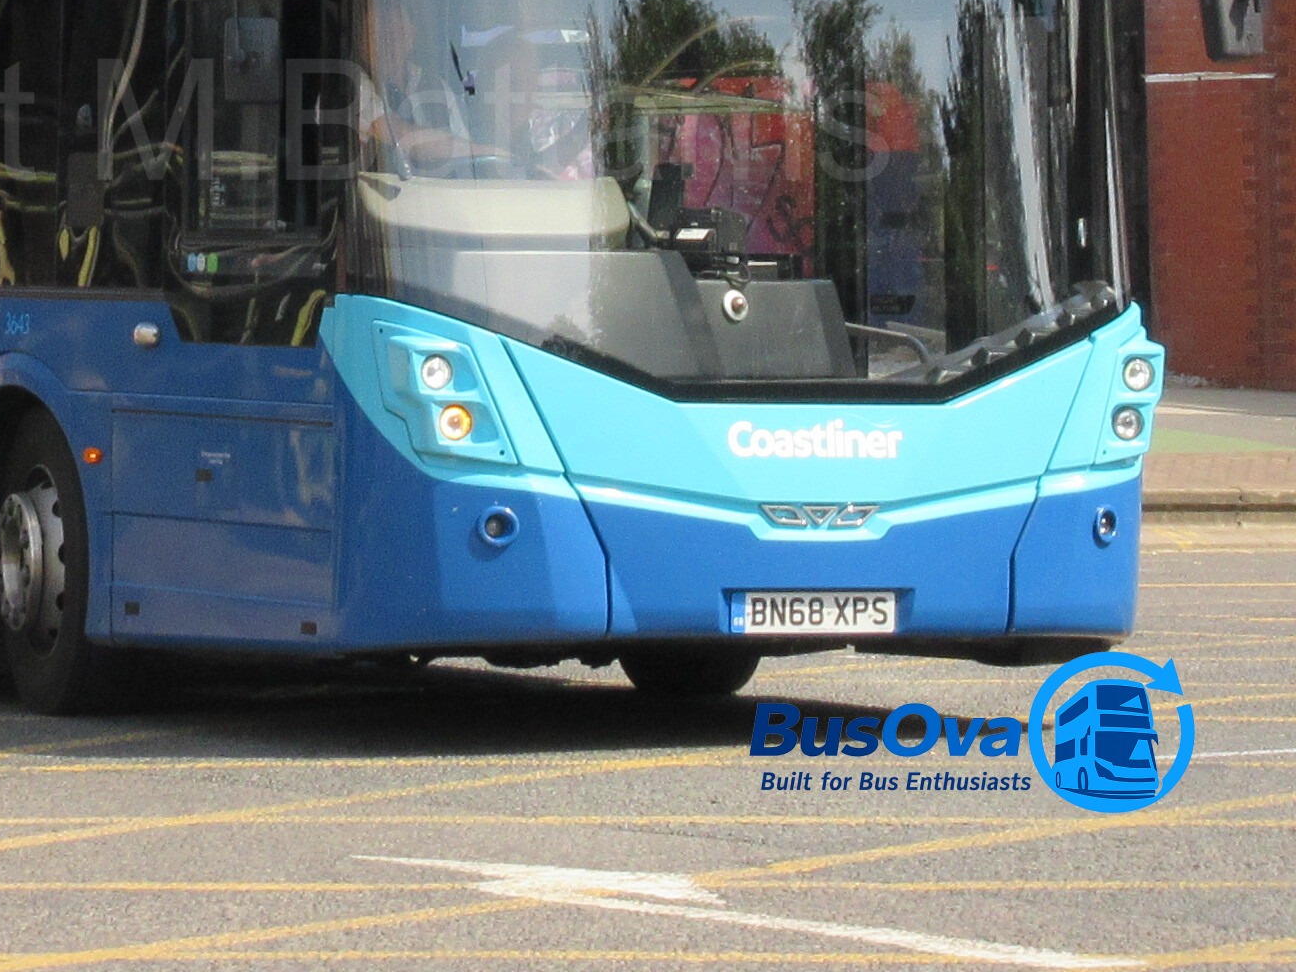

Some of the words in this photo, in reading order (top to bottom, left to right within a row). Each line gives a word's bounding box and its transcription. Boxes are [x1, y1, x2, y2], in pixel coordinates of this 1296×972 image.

[727, 418, 904, 458] Coastliner
[750, 596, 824, 627] BN68
[834, 596, 888, 626] XPS
